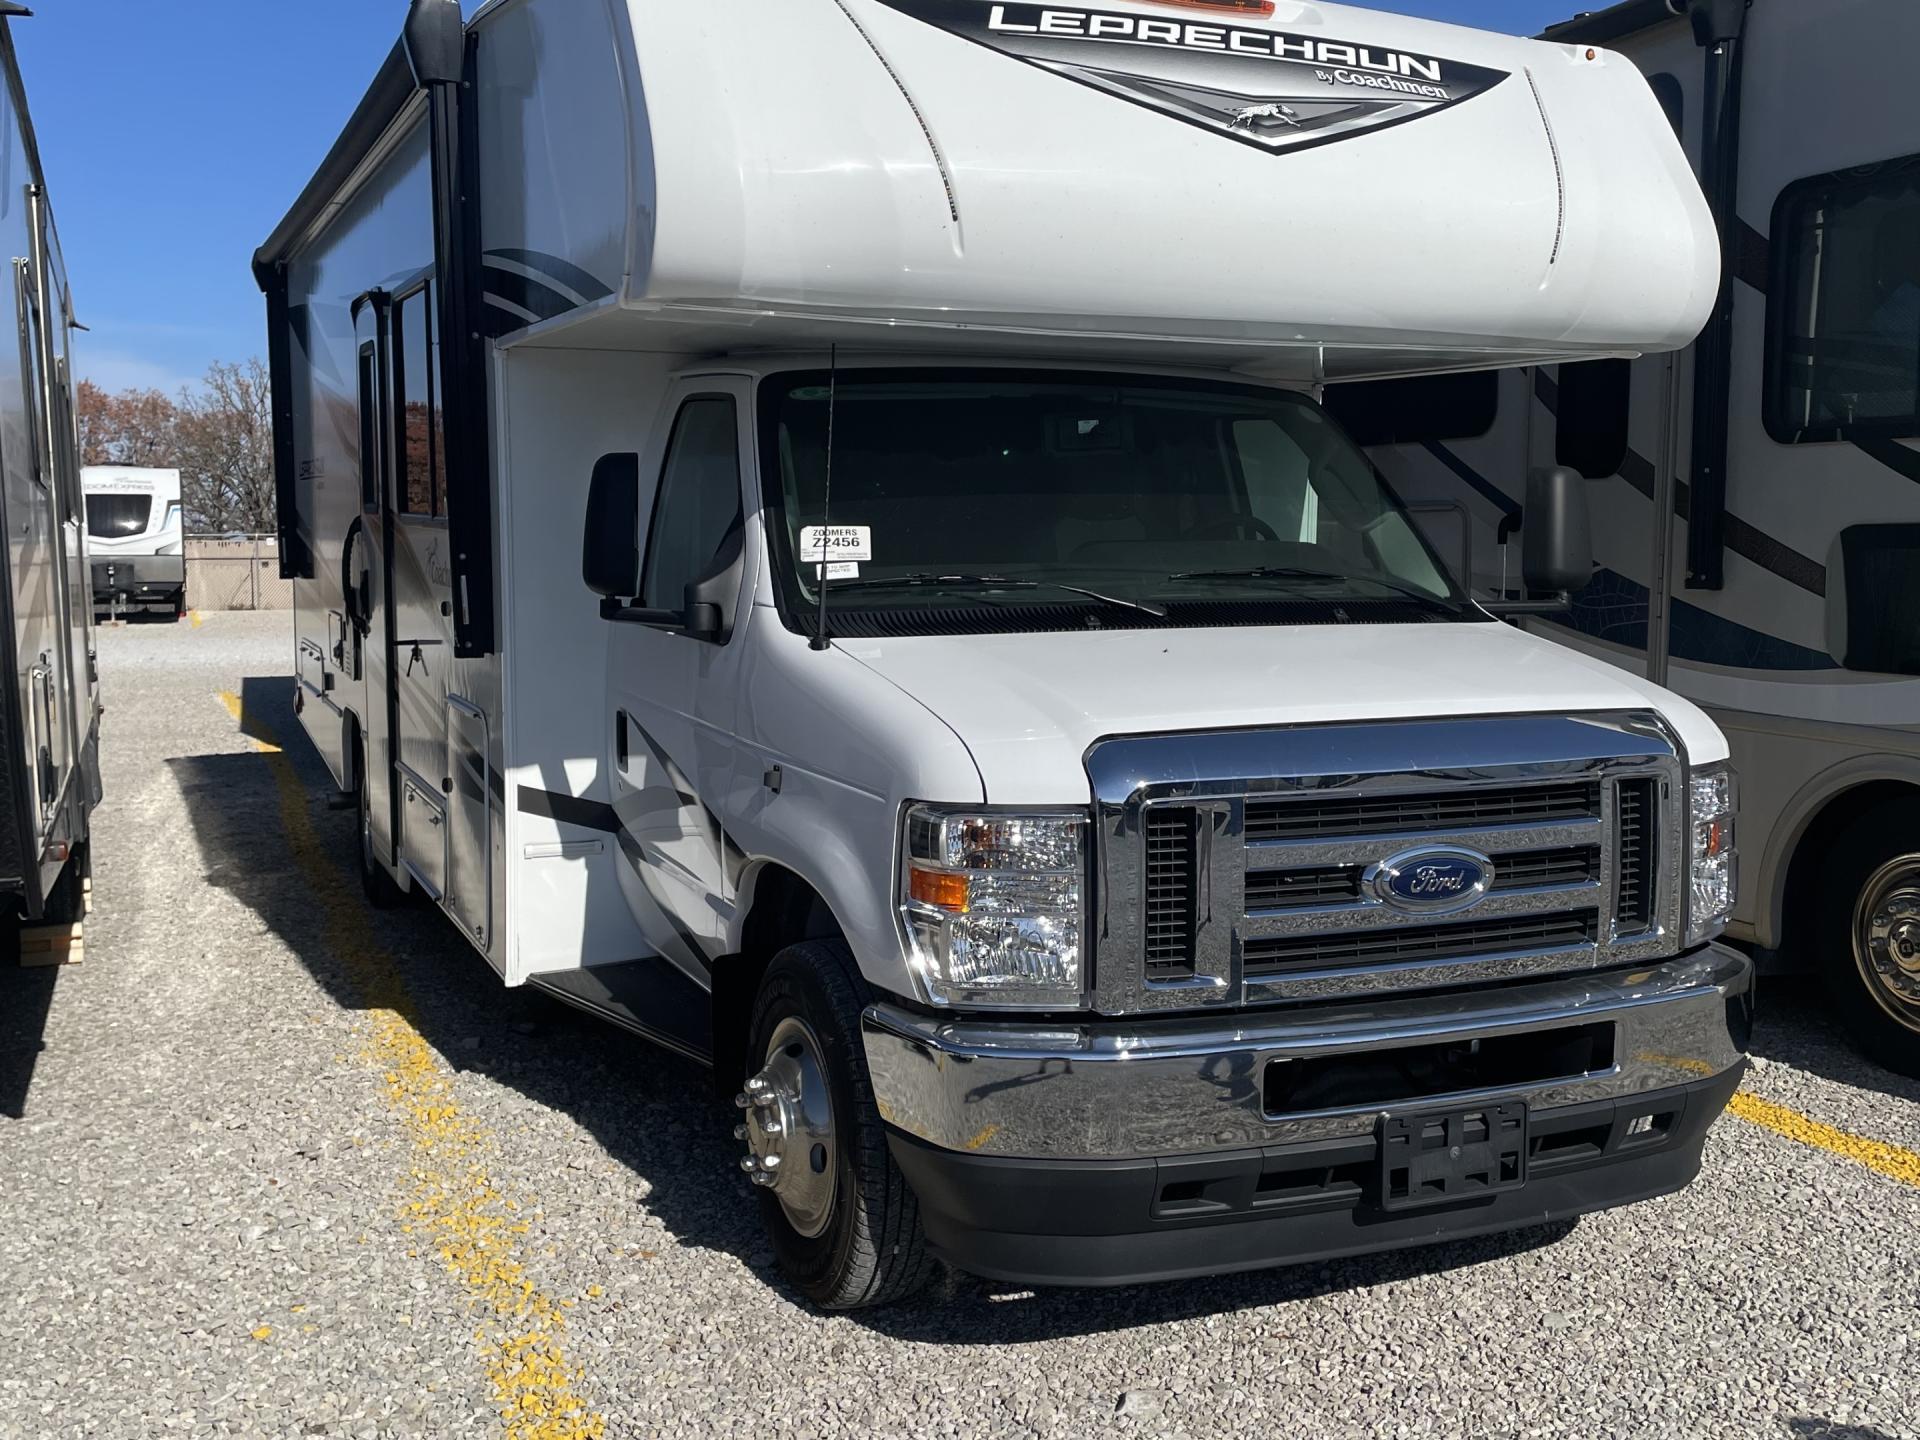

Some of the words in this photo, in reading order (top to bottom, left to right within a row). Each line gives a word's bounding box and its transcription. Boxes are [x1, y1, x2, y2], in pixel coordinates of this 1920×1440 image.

[988, 5, 1441, 81] LEPRECHAUN
[1314, 69, 1334, 85] By
[1334, 69, 1450, 99] Coachmen
[813, 528, 857, 537] ZOOMERS
[813, 537, 860, 548] Z2456
[1411, 865, 1465, 893] Ford
